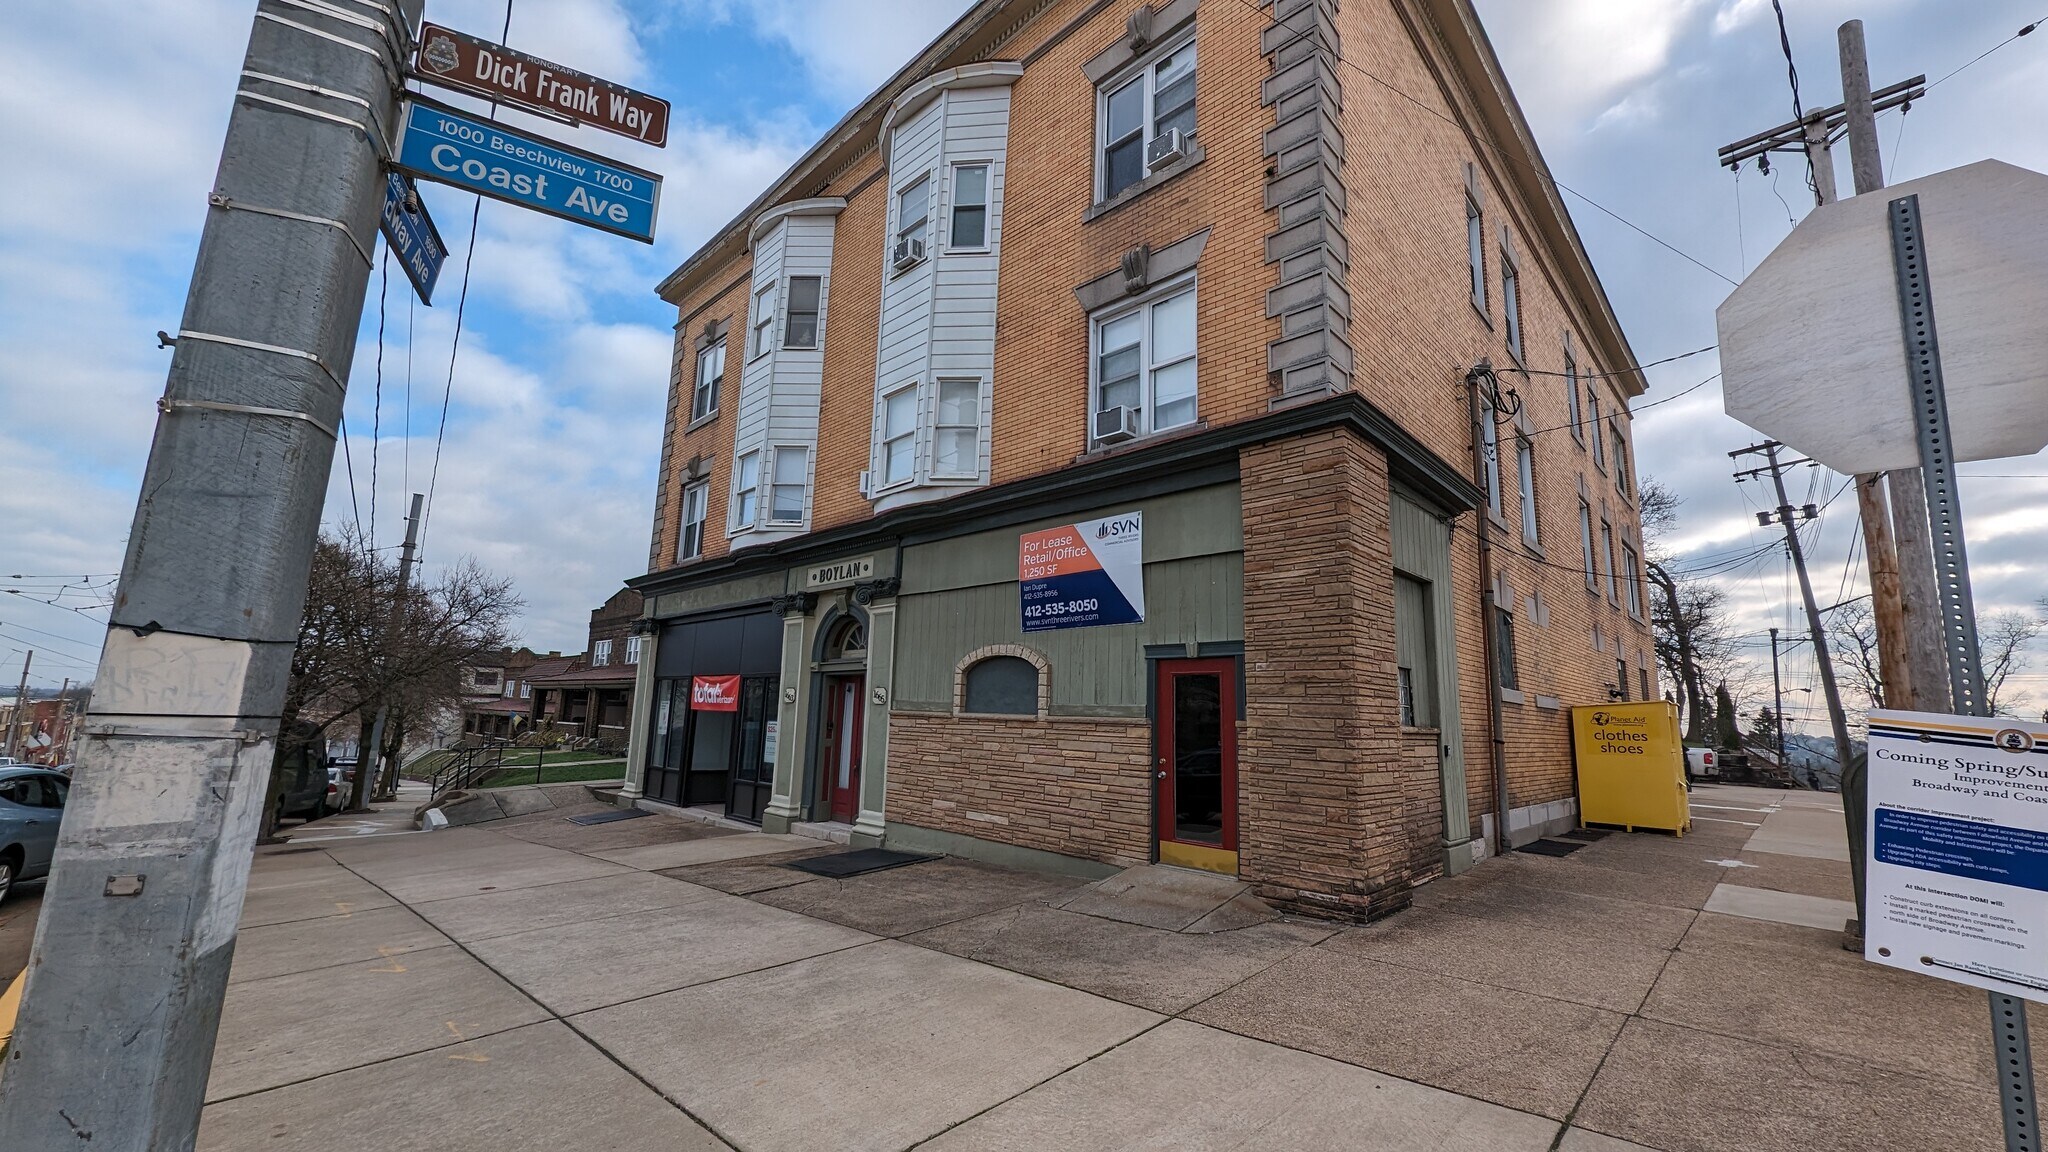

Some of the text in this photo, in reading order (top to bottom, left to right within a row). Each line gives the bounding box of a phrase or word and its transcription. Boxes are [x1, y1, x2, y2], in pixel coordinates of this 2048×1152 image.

[527, 56, 580, 77] HONORARY
[476, 50, 653, 140] Dick Frank Way
[437, 119, 633, 192] 1000 Beechview 1700
[430, 144, 629, 223] Coast Ave
[411, 248, 429, 283] Ave
[1111, 517, 1139, 536] SVN
[1024, 535, 1073, 553] For Lease
[1023, 546, 1087, 566] Retail/Office
[819, 561, 861, 583] BOYLAN
[1024, 563, 1058, 579] 1,250 SF
[1032, 583, 1047, 591] Dupre
[1024, 598, 1098, 618] 412-535-8050
[1026, 613, 1099, 627] www.svnthreerivers.com
[1594, 729, 1648, 742] clothes
[1601, 741, 1644, 755] shoes
[1876, 748, 2048, 779] Coming Spring/Su
[1912, 778, 2048, 804] Broadway and Coas
[1907, 805, 1930, 813] corridor
[1931, 809, 1970, 820] improvement
[1971, 815, 1995, 824] project:
[1887, 842, 1914, 852] Enhancing
[1928, 888, 1969, 900] intersection
[1970, 896, 1989, 904] DOMI
[1990, 900, 2006, 908] will:
[1889, 894, 1919, 905] Construct
[1934, 903, 1969, 915] extensions
[1989, 916, 2016, 925] corners.
[1890, 902, 1908, 910] Install
[1914, 907, 1937, 916] marked
[1938, 912, 1972, 924] pedestrian
[1973, 919, 2006, 930] crosswalk
[1889, 916, 1908, 924] Install
[1922, 923, 1947, 933] signage
[1948, 928, 1960, 936] and
[1961, 931, 1993, 943] pavement
[1993, 938, 2028, 950] markings.
[1928, 917, 1959, 929] Broadway
[1960, 924, 1985, 933] Avenue.
